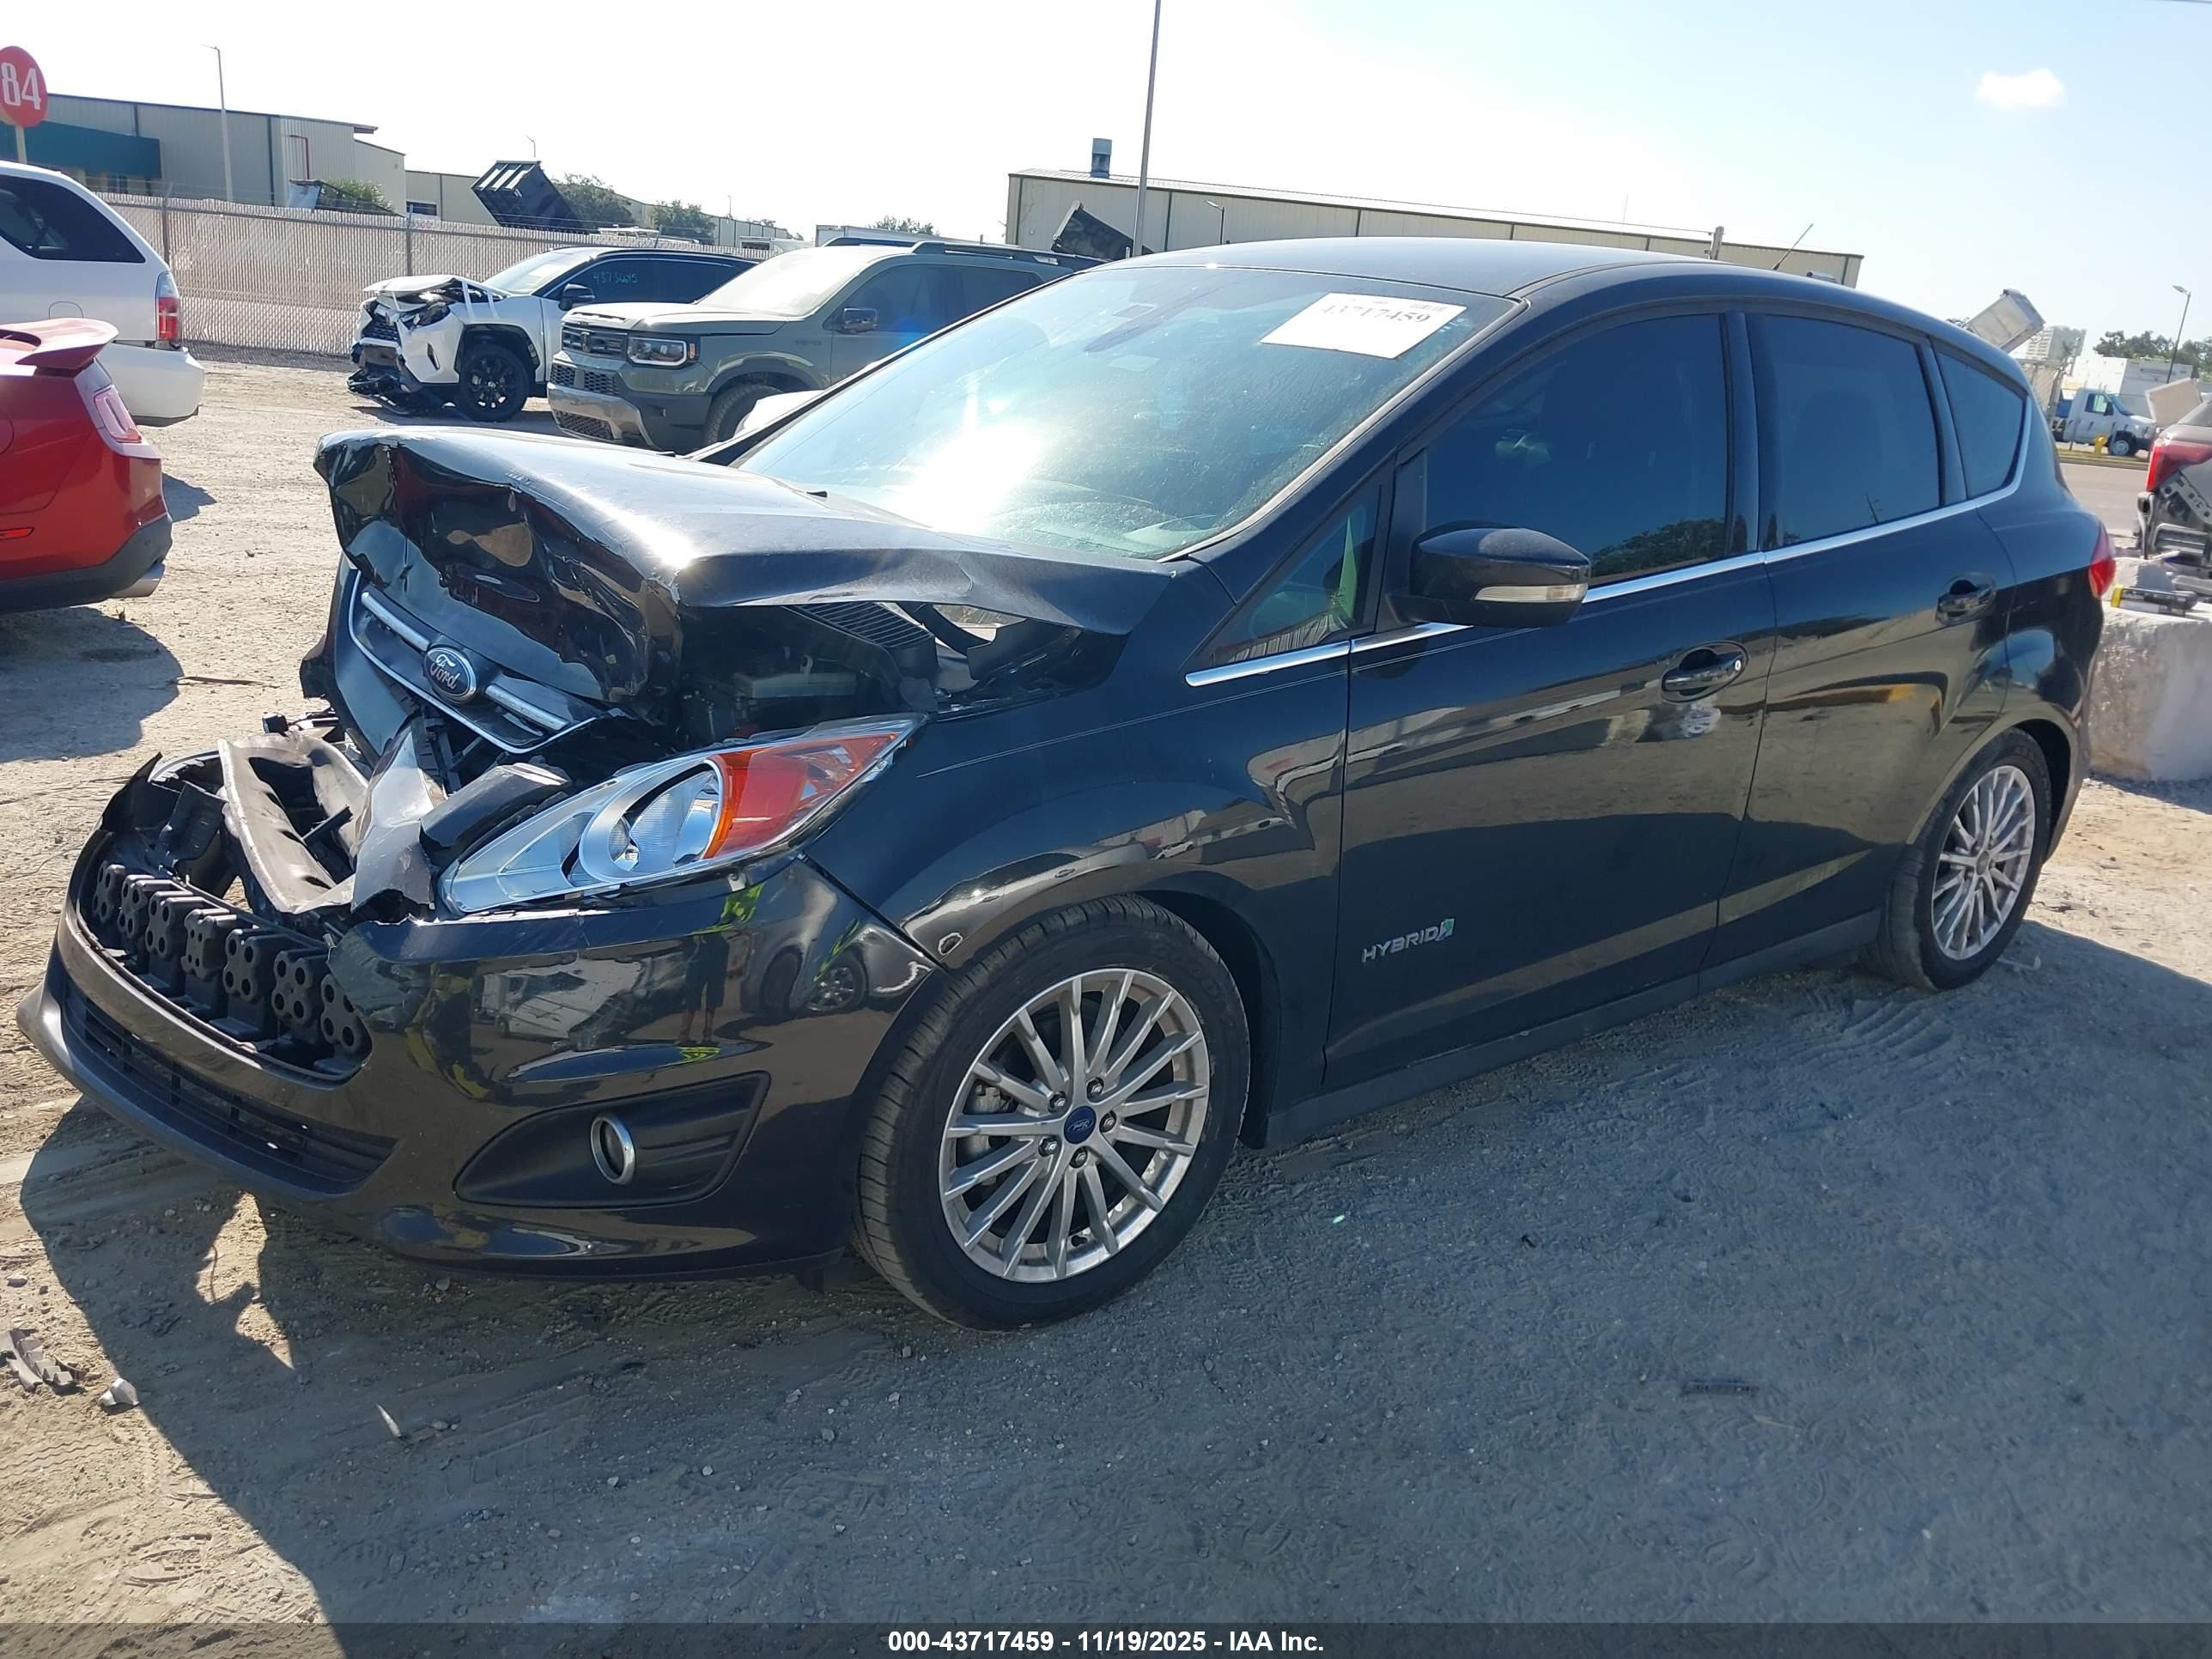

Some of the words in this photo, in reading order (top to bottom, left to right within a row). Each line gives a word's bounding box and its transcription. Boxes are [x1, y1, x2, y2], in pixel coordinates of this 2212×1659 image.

[1, 62, 41, 110] 84
[430, 653, 461, 690] Ford
[1361, 926, 1439, 963] HYBRID
